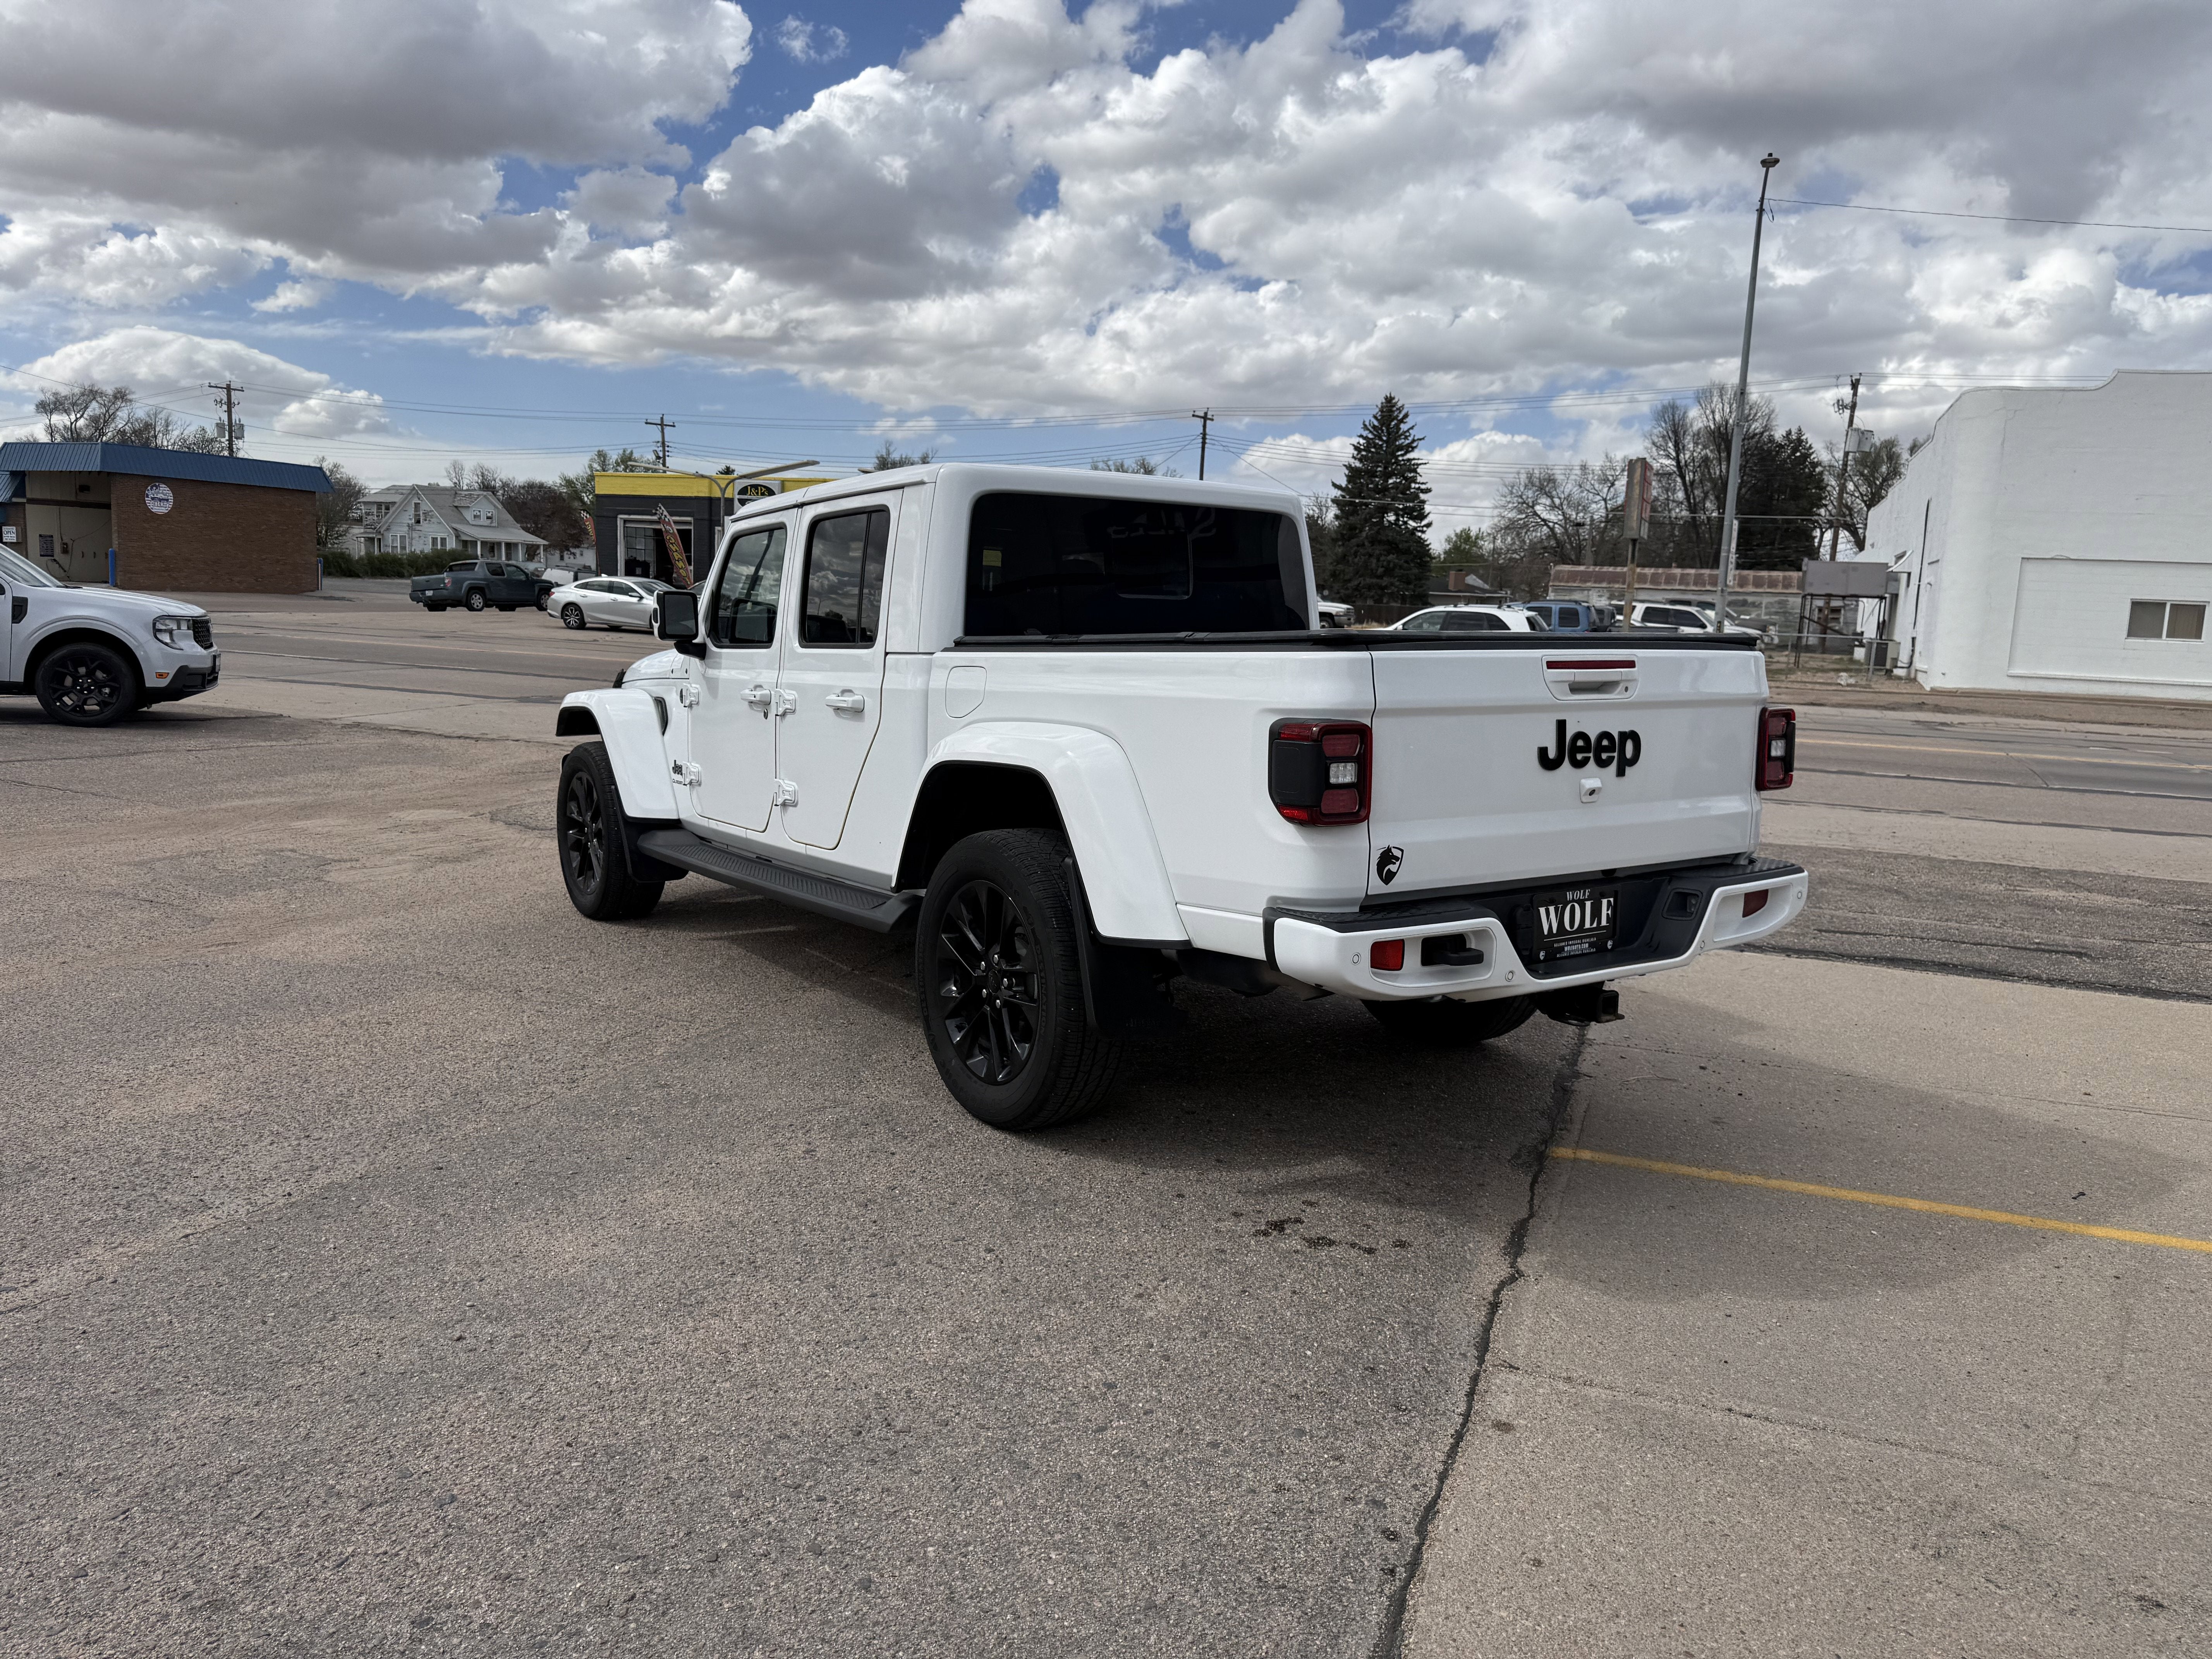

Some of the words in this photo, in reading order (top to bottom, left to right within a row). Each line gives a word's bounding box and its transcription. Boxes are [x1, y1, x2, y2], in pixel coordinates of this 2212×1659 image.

[747, 486, 768, 496] J&P's
[1537, 719, 1641, 777] Jeep
[1566, 889, 1590, 901] WOLF
[1538, 898, 1614, 935] WOLF
